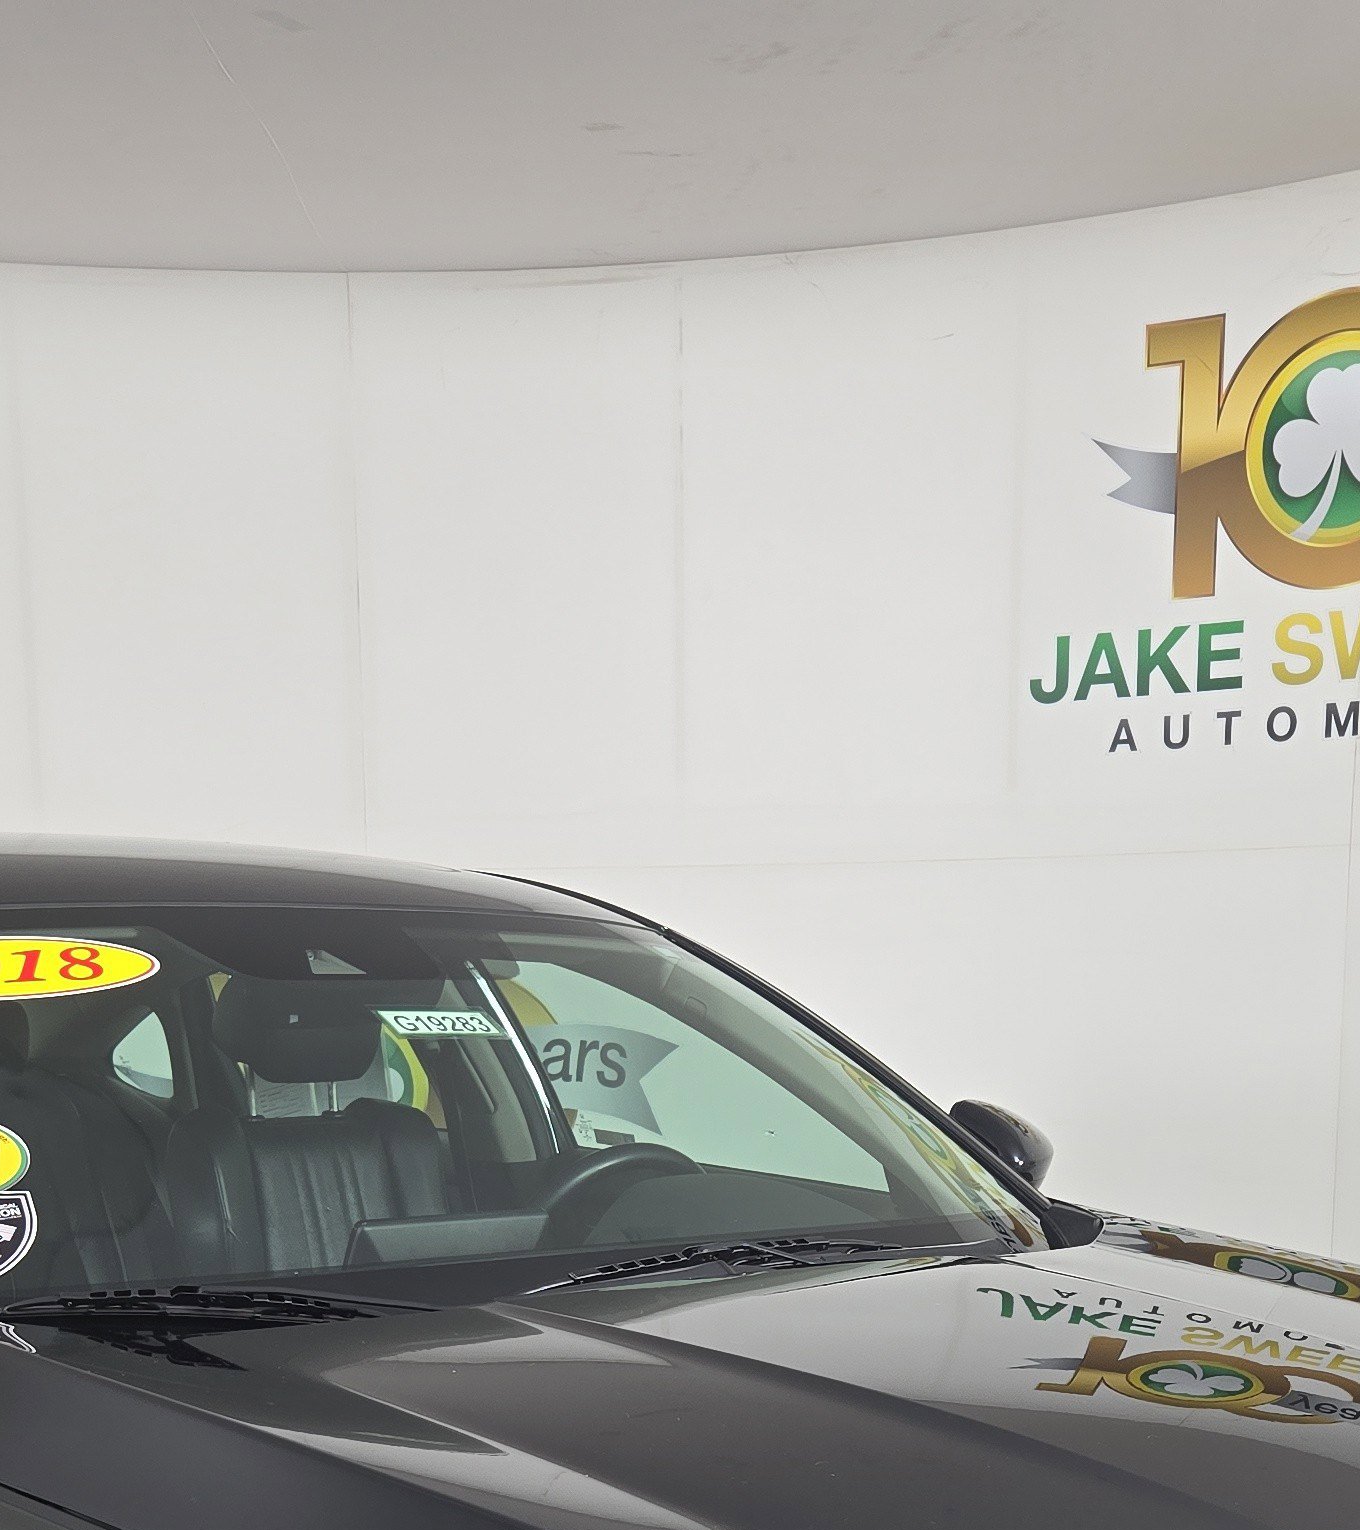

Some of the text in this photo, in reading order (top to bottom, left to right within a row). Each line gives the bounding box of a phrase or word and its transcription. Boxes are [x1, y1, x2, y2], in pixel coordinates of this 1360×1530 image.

[1029, 620, 1245, 705] JAKE
[393, 1015, 491, 1033] G19283
[540, 1037, 628, 1089] ars
